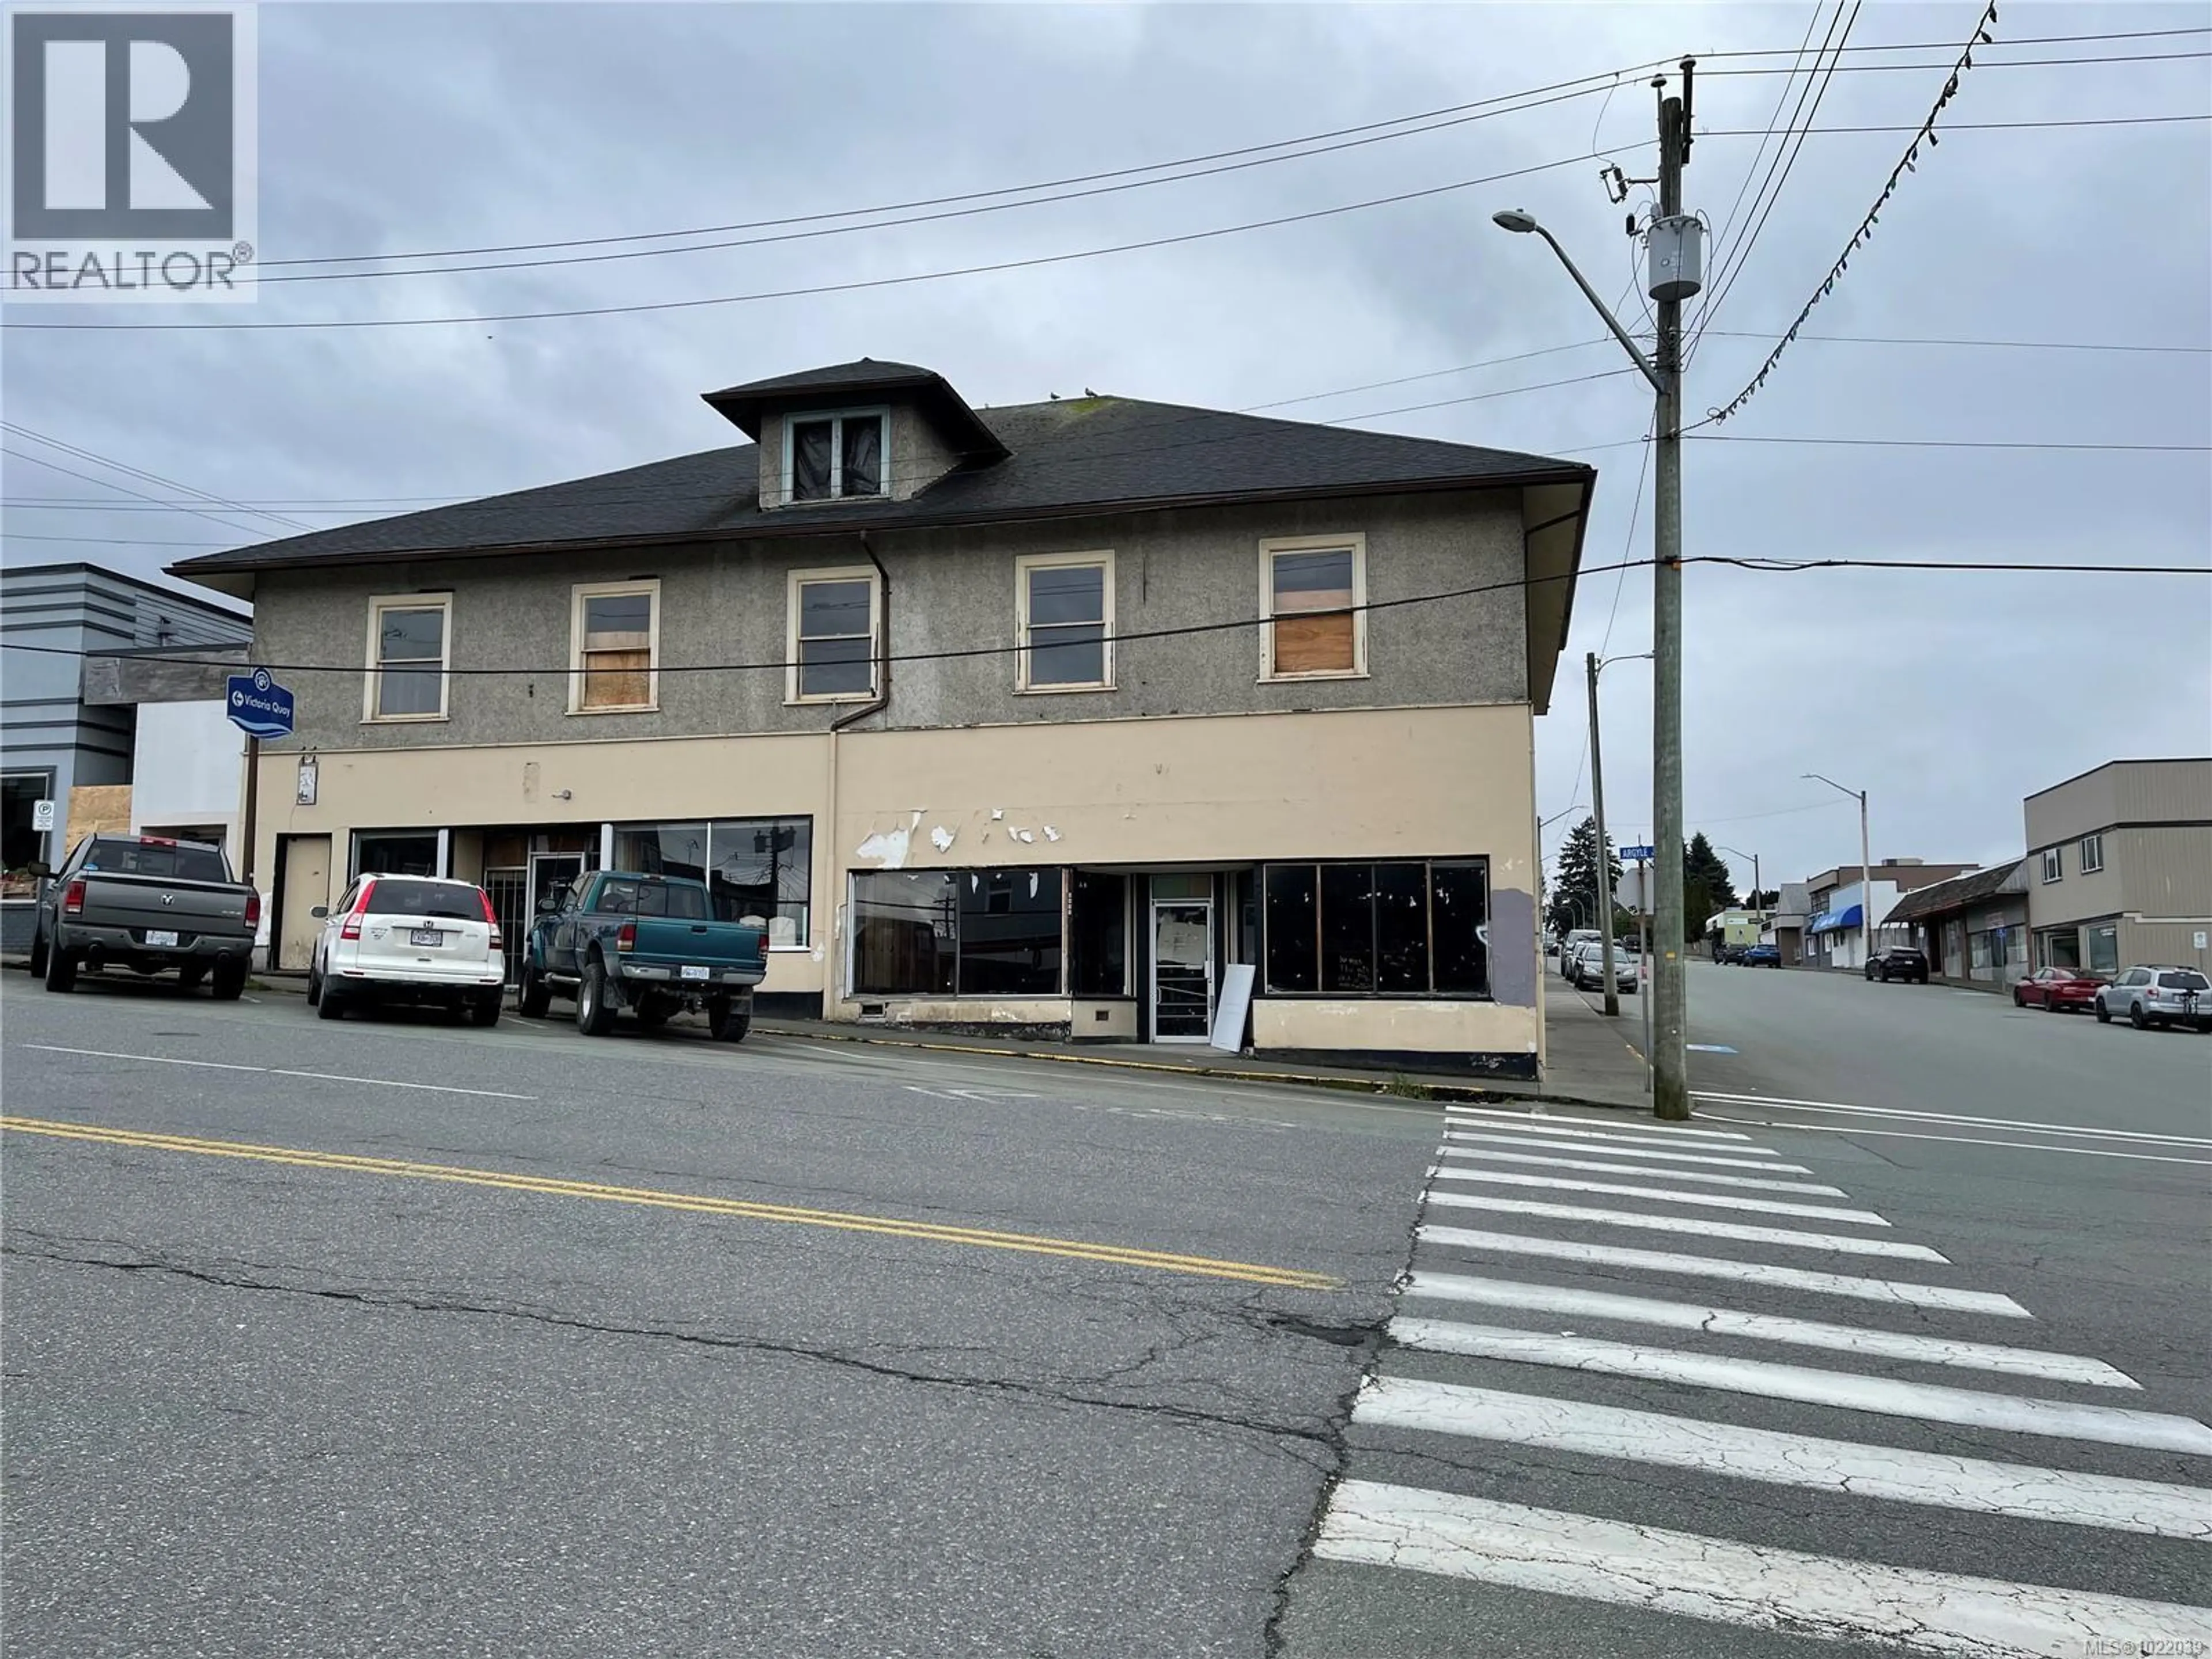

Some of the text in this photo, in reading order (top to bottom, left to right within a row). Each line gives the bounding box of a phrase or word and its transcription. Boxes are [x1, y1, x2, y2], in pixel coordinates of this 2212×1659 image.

[245, 694, 290, 718] Victoria Quay
[1622, 848, 1647, 858] ARGYLE
